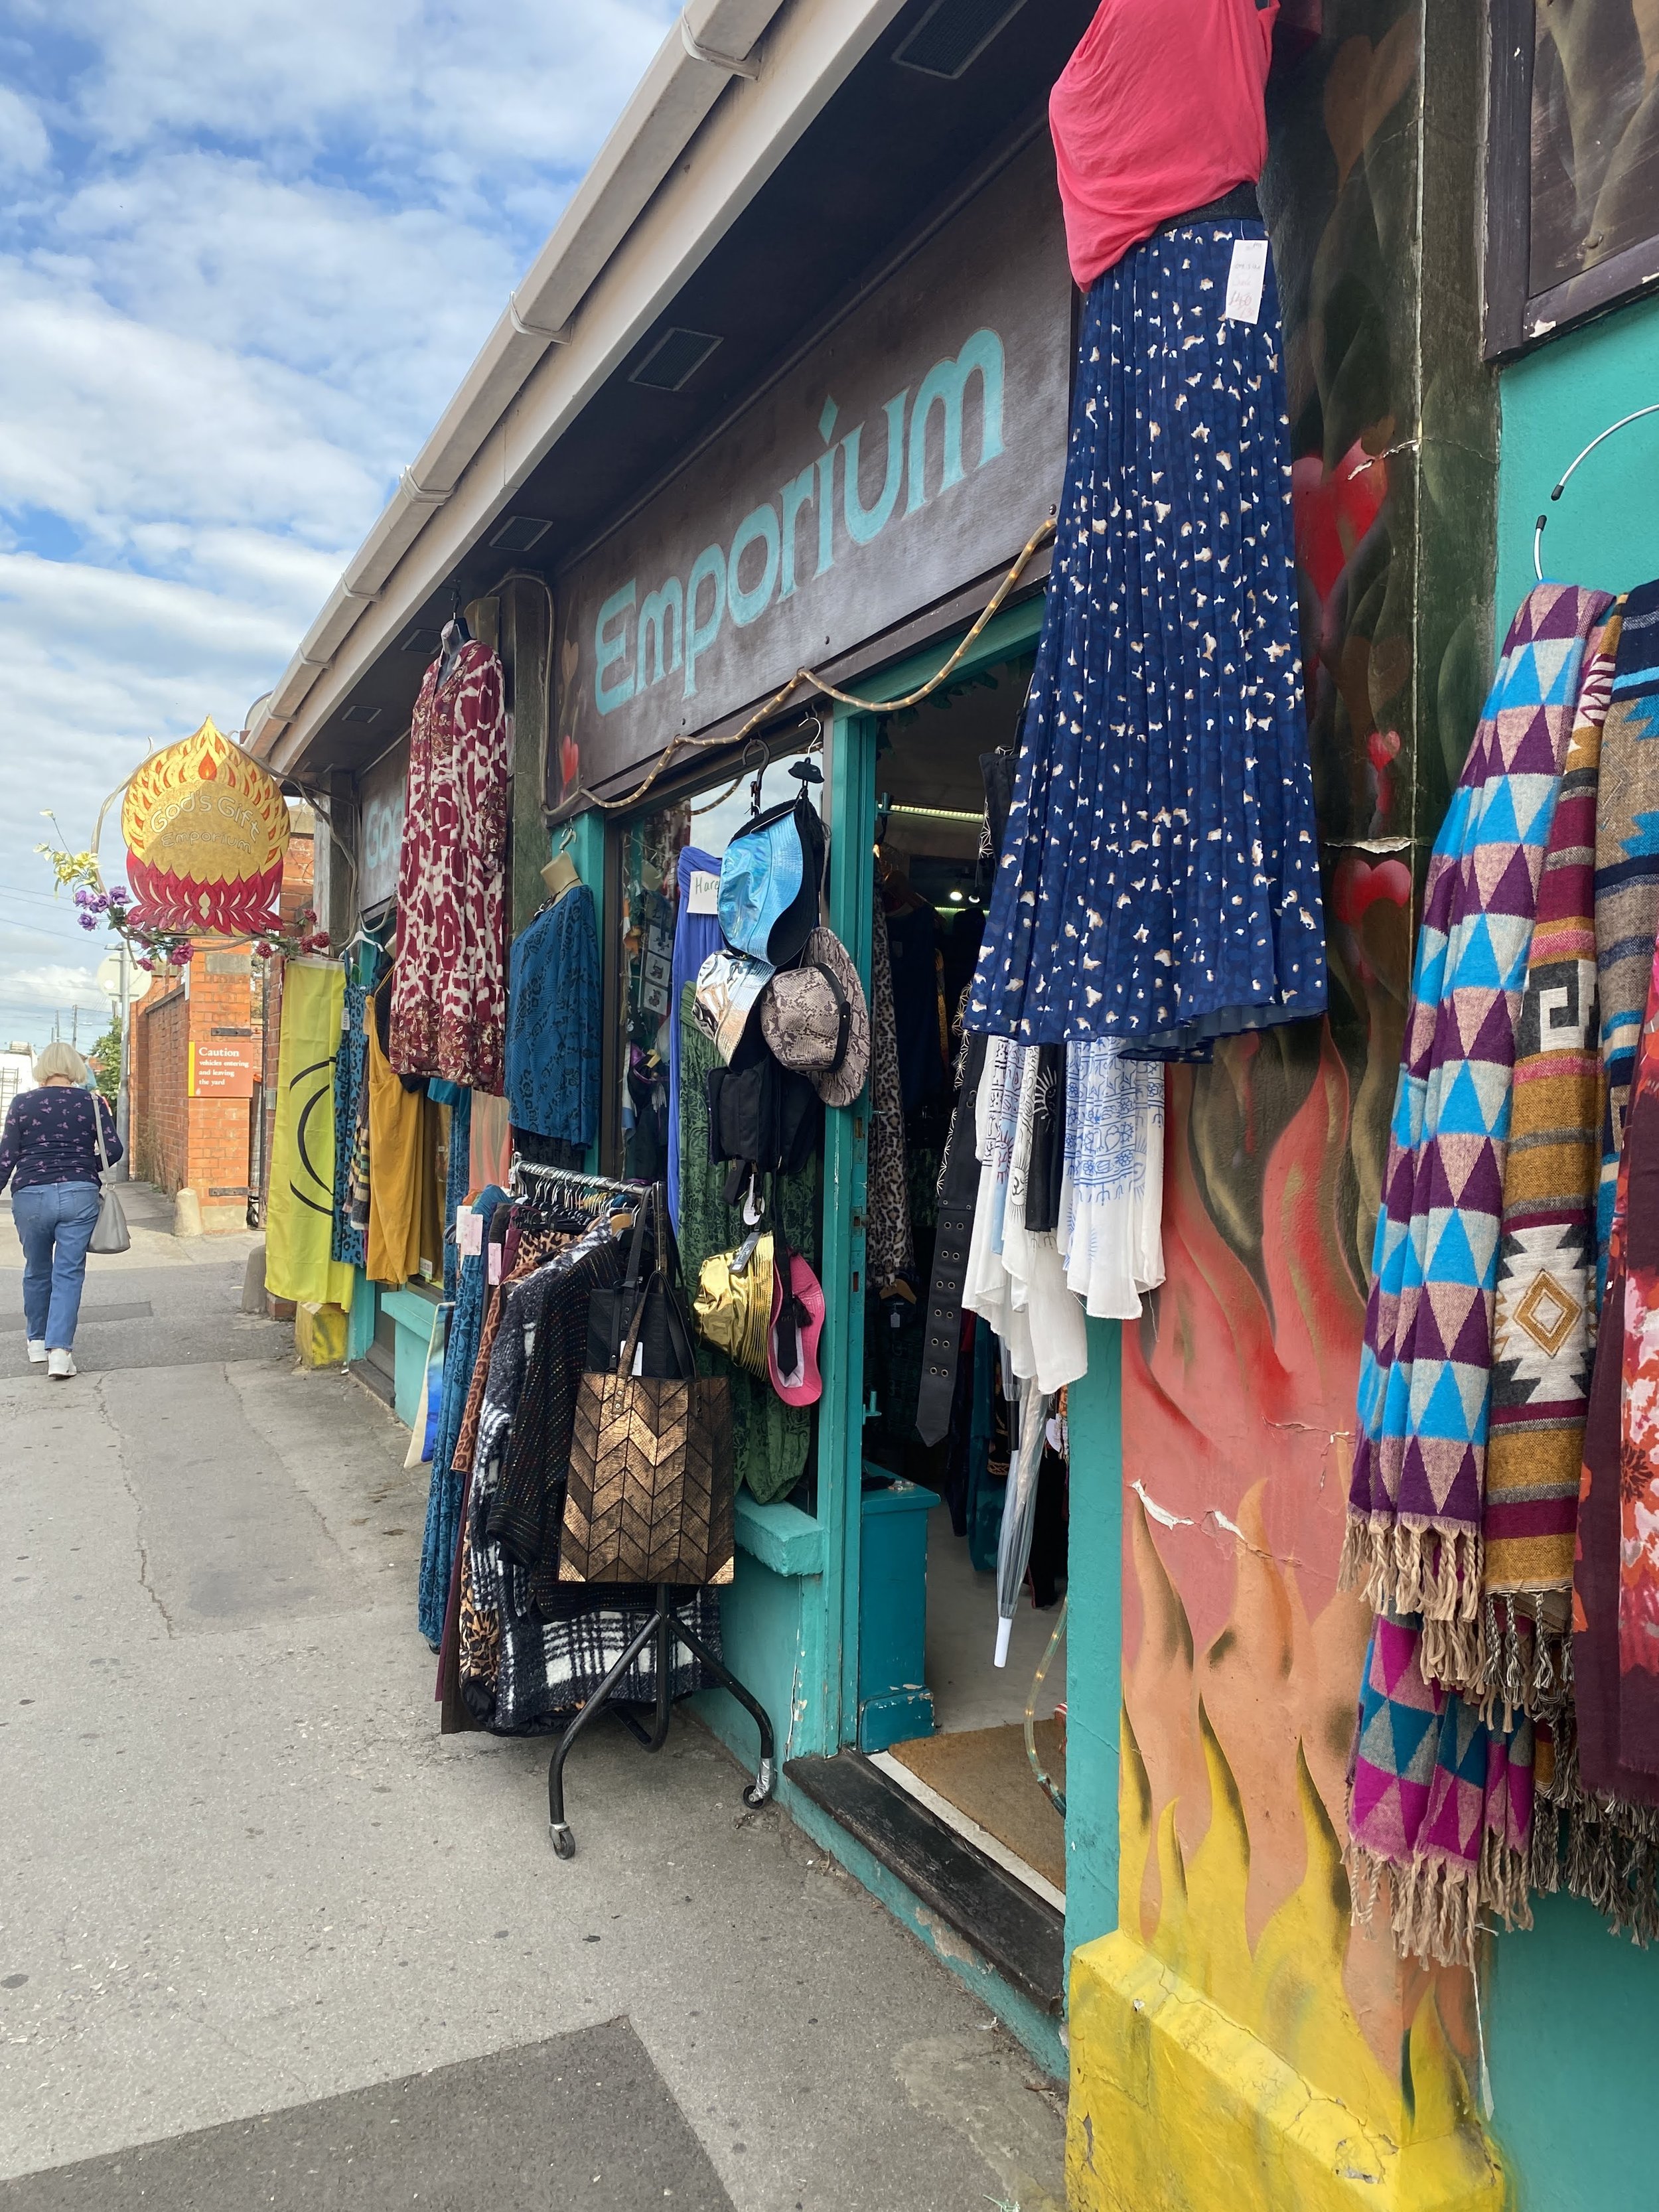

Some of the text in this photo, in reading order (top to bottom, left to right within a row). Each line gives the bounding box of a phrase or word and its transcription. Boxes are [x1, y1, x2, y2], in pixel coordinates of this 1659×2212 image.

[594, 327, 1007, 716] Emporium
[151, 791, 261, 844] God's Gift
[161, 831, 252, 855] Emporium
[198, 1047, 240, 1057] Caution
[212, 1069, 235, 1078] leaving
